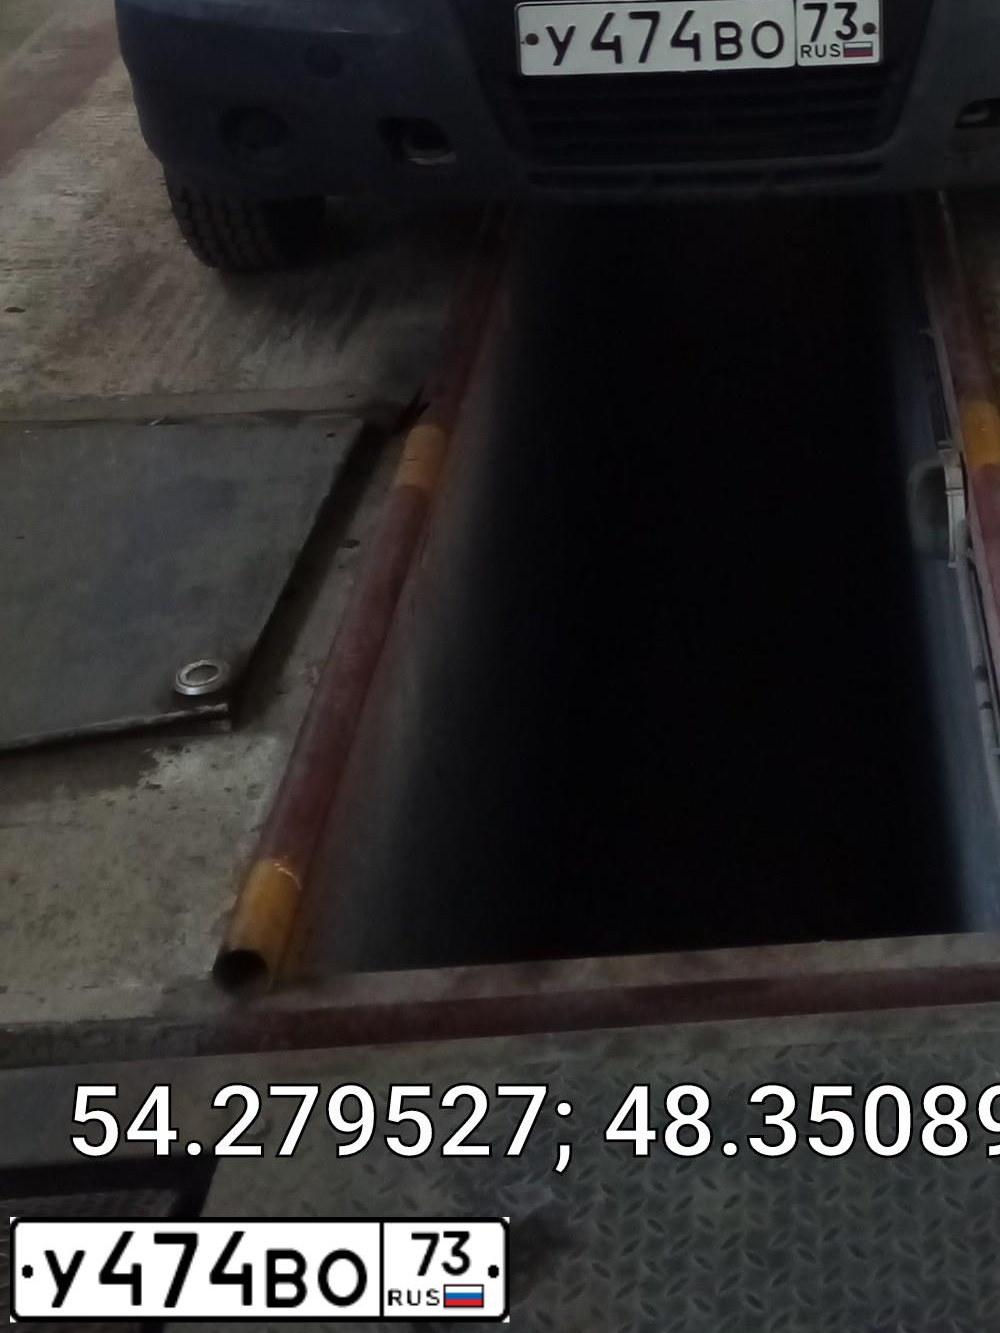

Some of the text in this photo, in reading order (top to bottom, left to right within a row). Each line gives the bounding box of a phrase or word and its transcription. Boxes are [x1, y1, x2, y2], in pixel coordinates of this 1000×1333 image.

[545, 2, 858, 66] У474ВО 73
[800, 43, 841, 59] RUS
